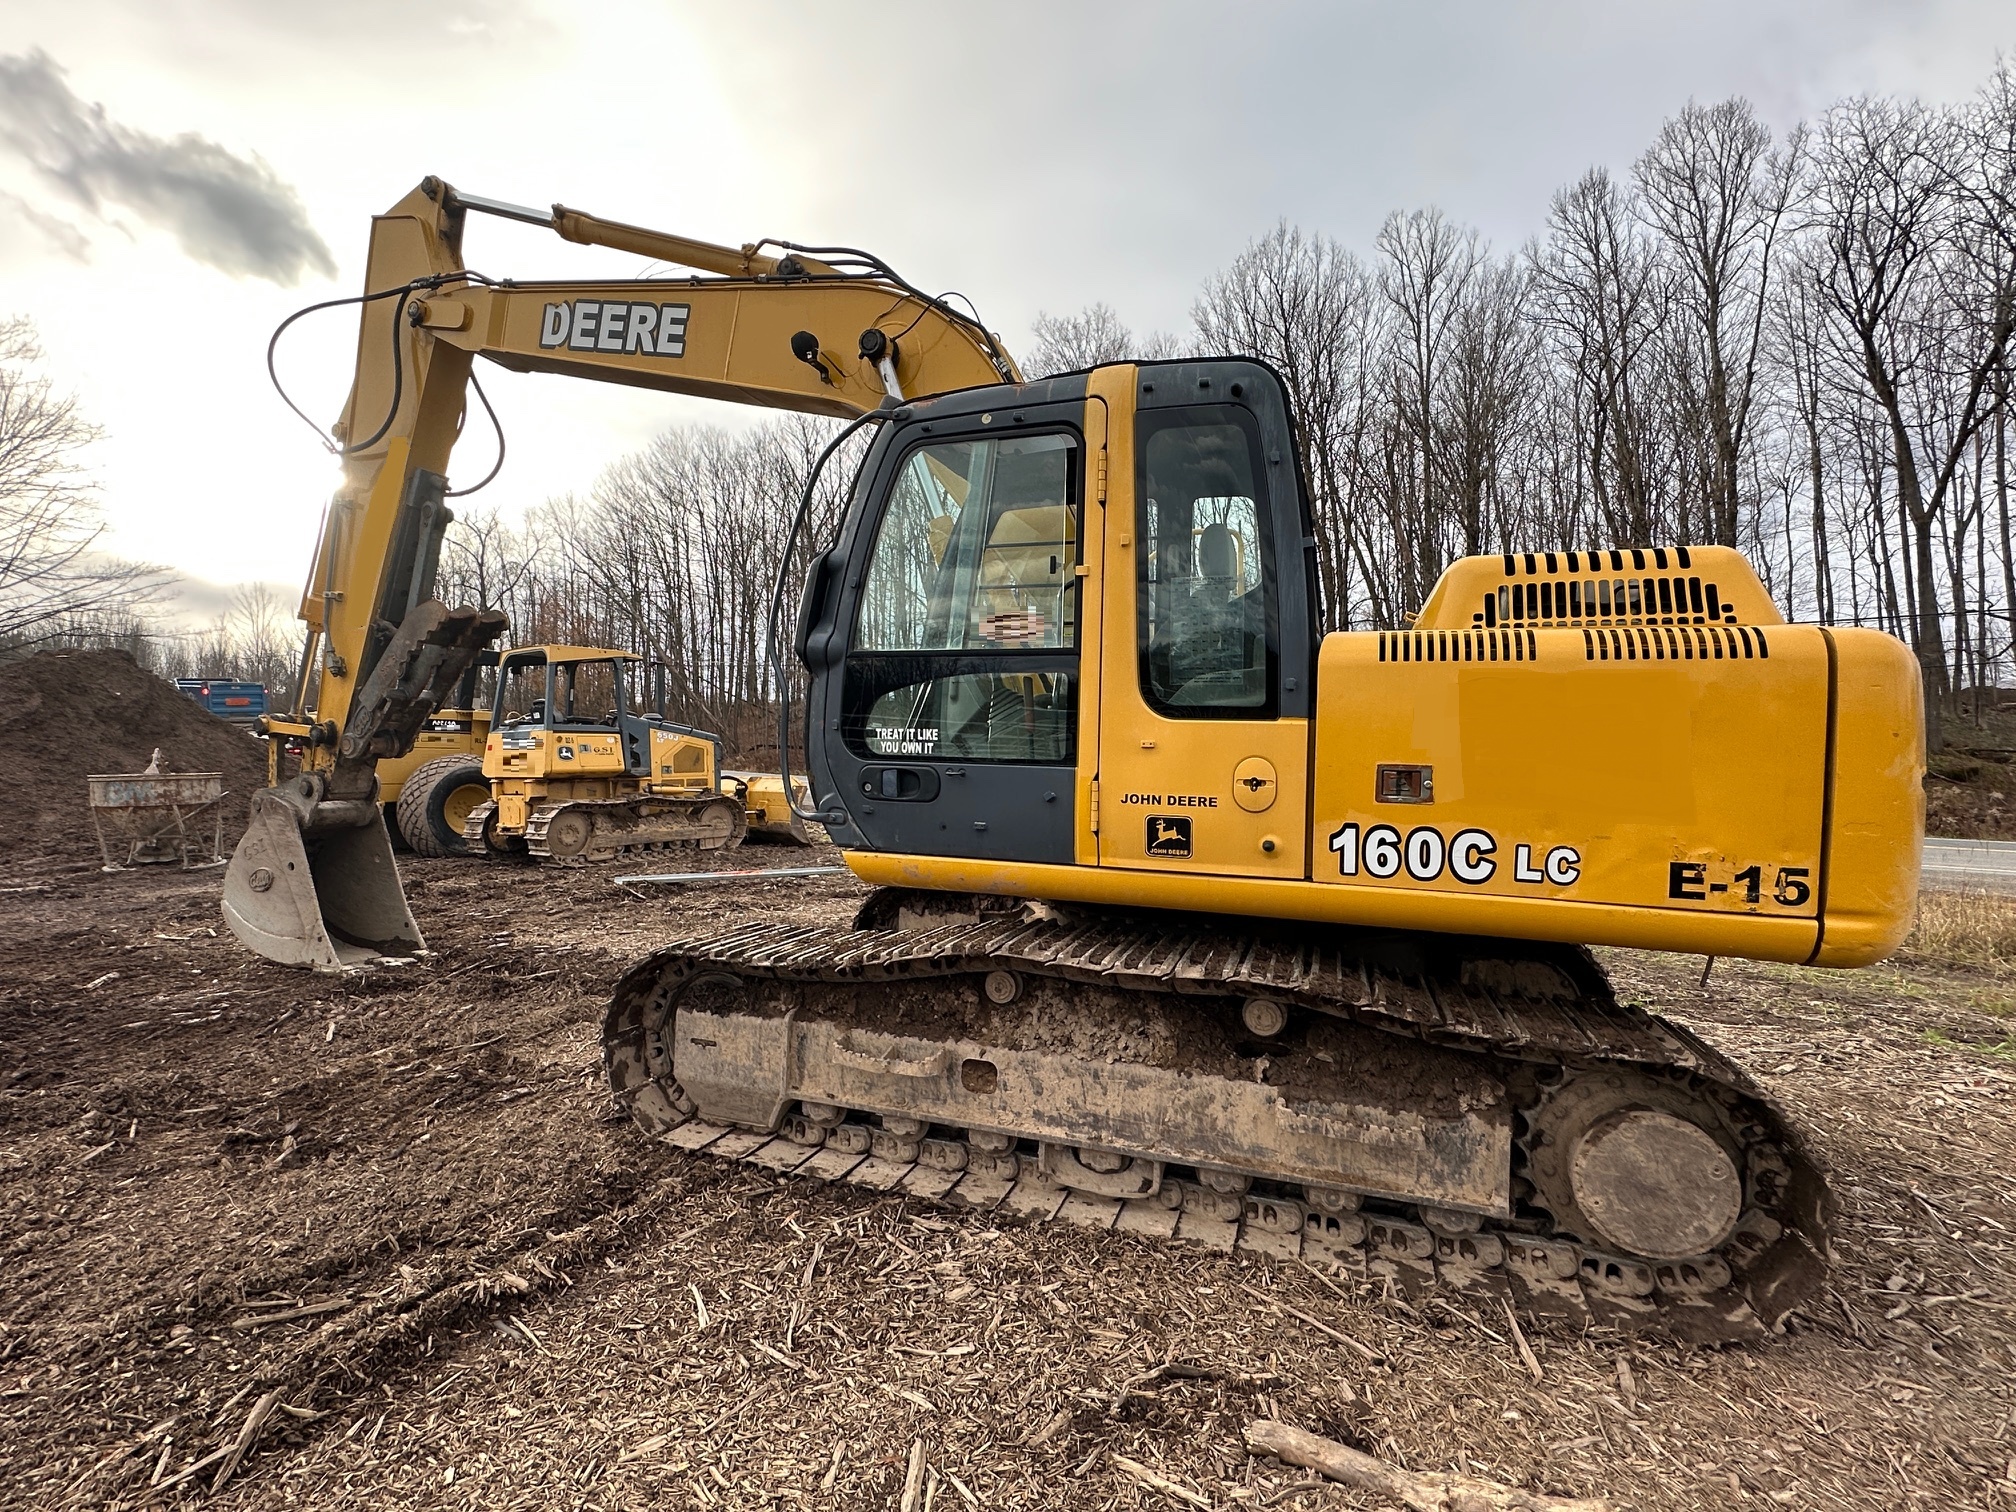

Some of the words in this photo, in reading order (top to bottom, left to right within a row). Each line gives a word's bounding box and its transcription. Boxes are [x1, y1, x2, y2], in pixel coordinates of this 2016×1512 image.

[540, 299, 691, 358] DEERE
[656, 731, 679, 741] 650J
[876, 728, 904, 740] TREAT
[906, 728, 916, 740] IT
[917, 728, 939, 740] LIKE
[880, 741, 899, 753] YOU
[901, 741, 922, 754] OWN
[924, 742, 934, 754] IT
[1120, 793, 1162, 806] JOHN
[1167, 795, 1218, 808] DEERE
[1329, 822, 1498, 885] 160C
[1513, 843, 1581, 887] LC
[1669, 861, 1811, 907] E-15
